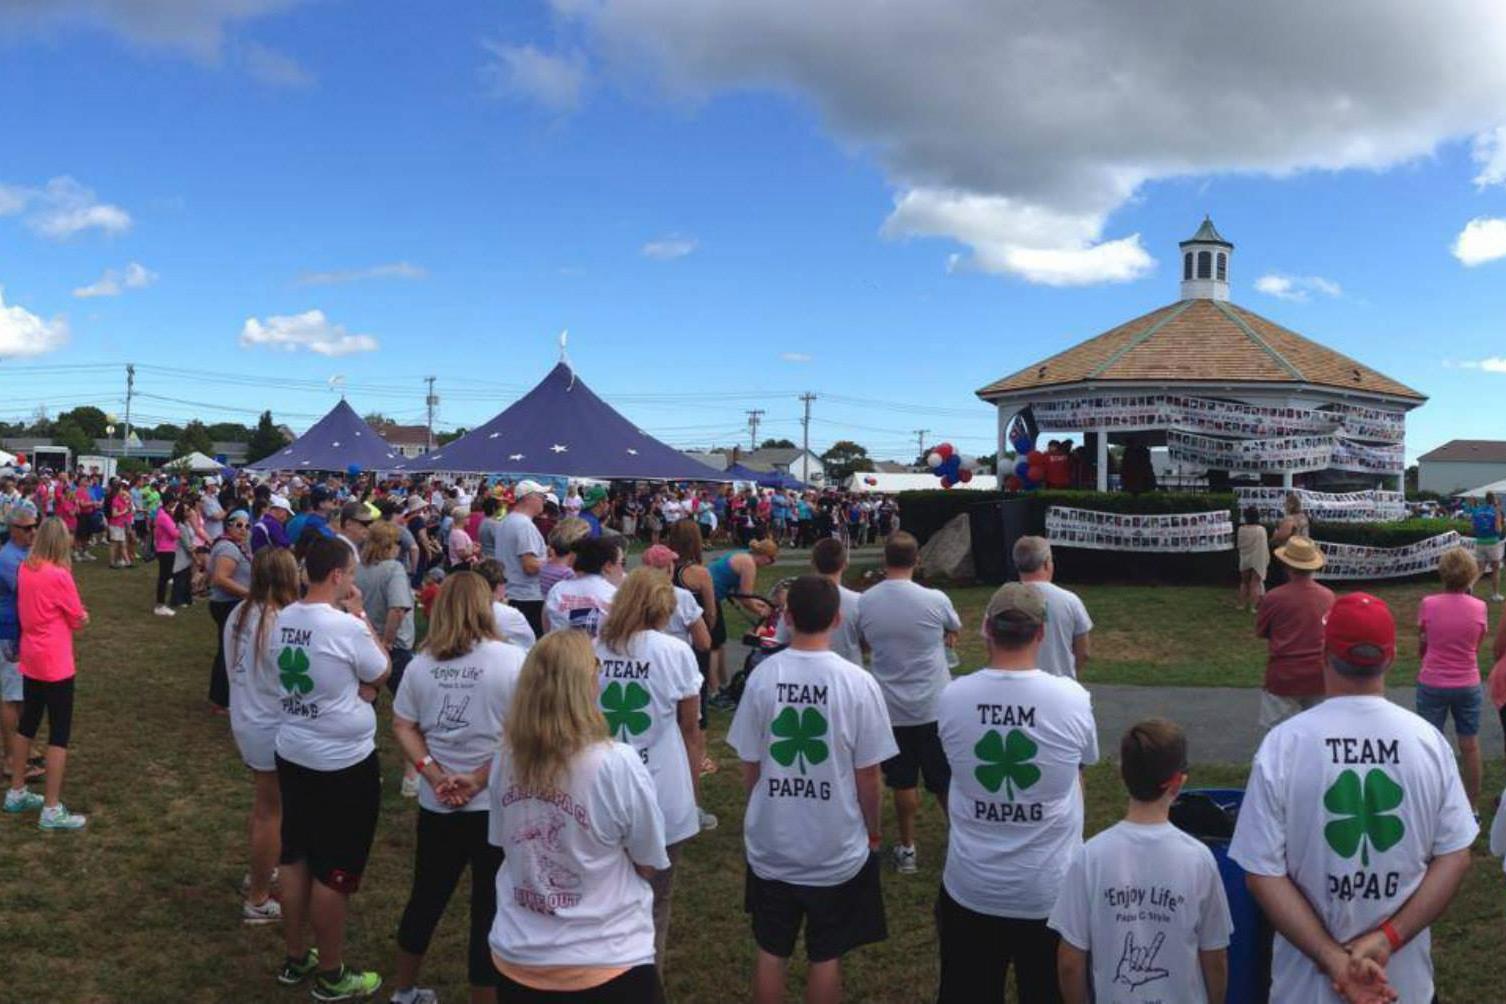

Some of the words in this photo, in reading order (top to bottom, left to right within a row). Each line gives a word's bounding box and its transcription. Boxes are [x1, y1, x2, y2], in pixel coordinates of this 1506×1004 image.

[281, 627, 312, 646] TEAM
[604, 660, 650, 679] TEAM
[776, 683, 828, 705] TEAM
[977, 704, 1036, 728] TEAM
[1325, 738, 1400, 764] TEAM
[768, 778, 817, 798] PAPA
[820, 781, 831, 801] G
[975, 800, 1027, 822] PAPA
[1030, 802, 1043, 821] G
[1328, 871, 1381, 901] PAPA
[1384, 871, 1400, 898] G
